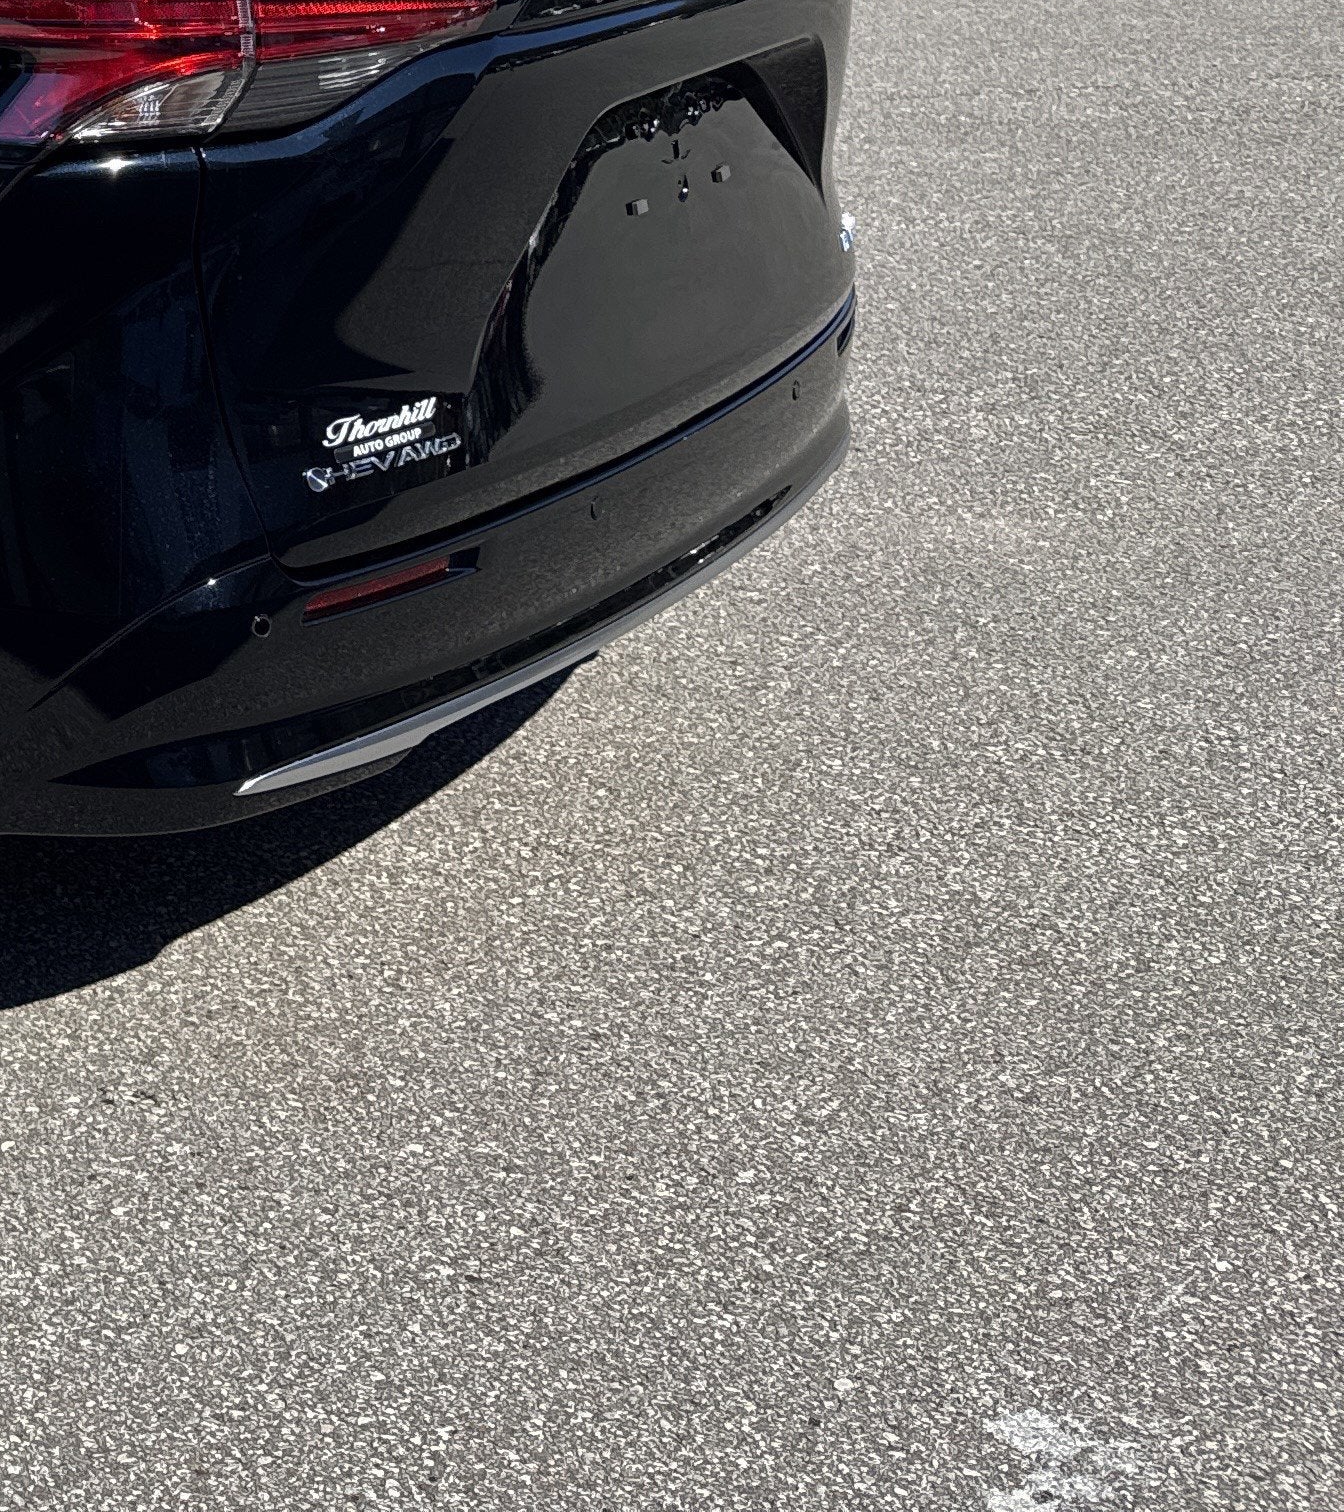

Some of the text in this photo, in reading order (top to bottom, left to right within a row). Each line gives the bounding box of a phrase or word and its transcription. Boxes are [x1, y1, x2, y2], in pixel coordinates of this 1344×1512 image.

[322, 396, 437, 447] Thornhill
[353, 427, 422, 458] AUTO GROUP
